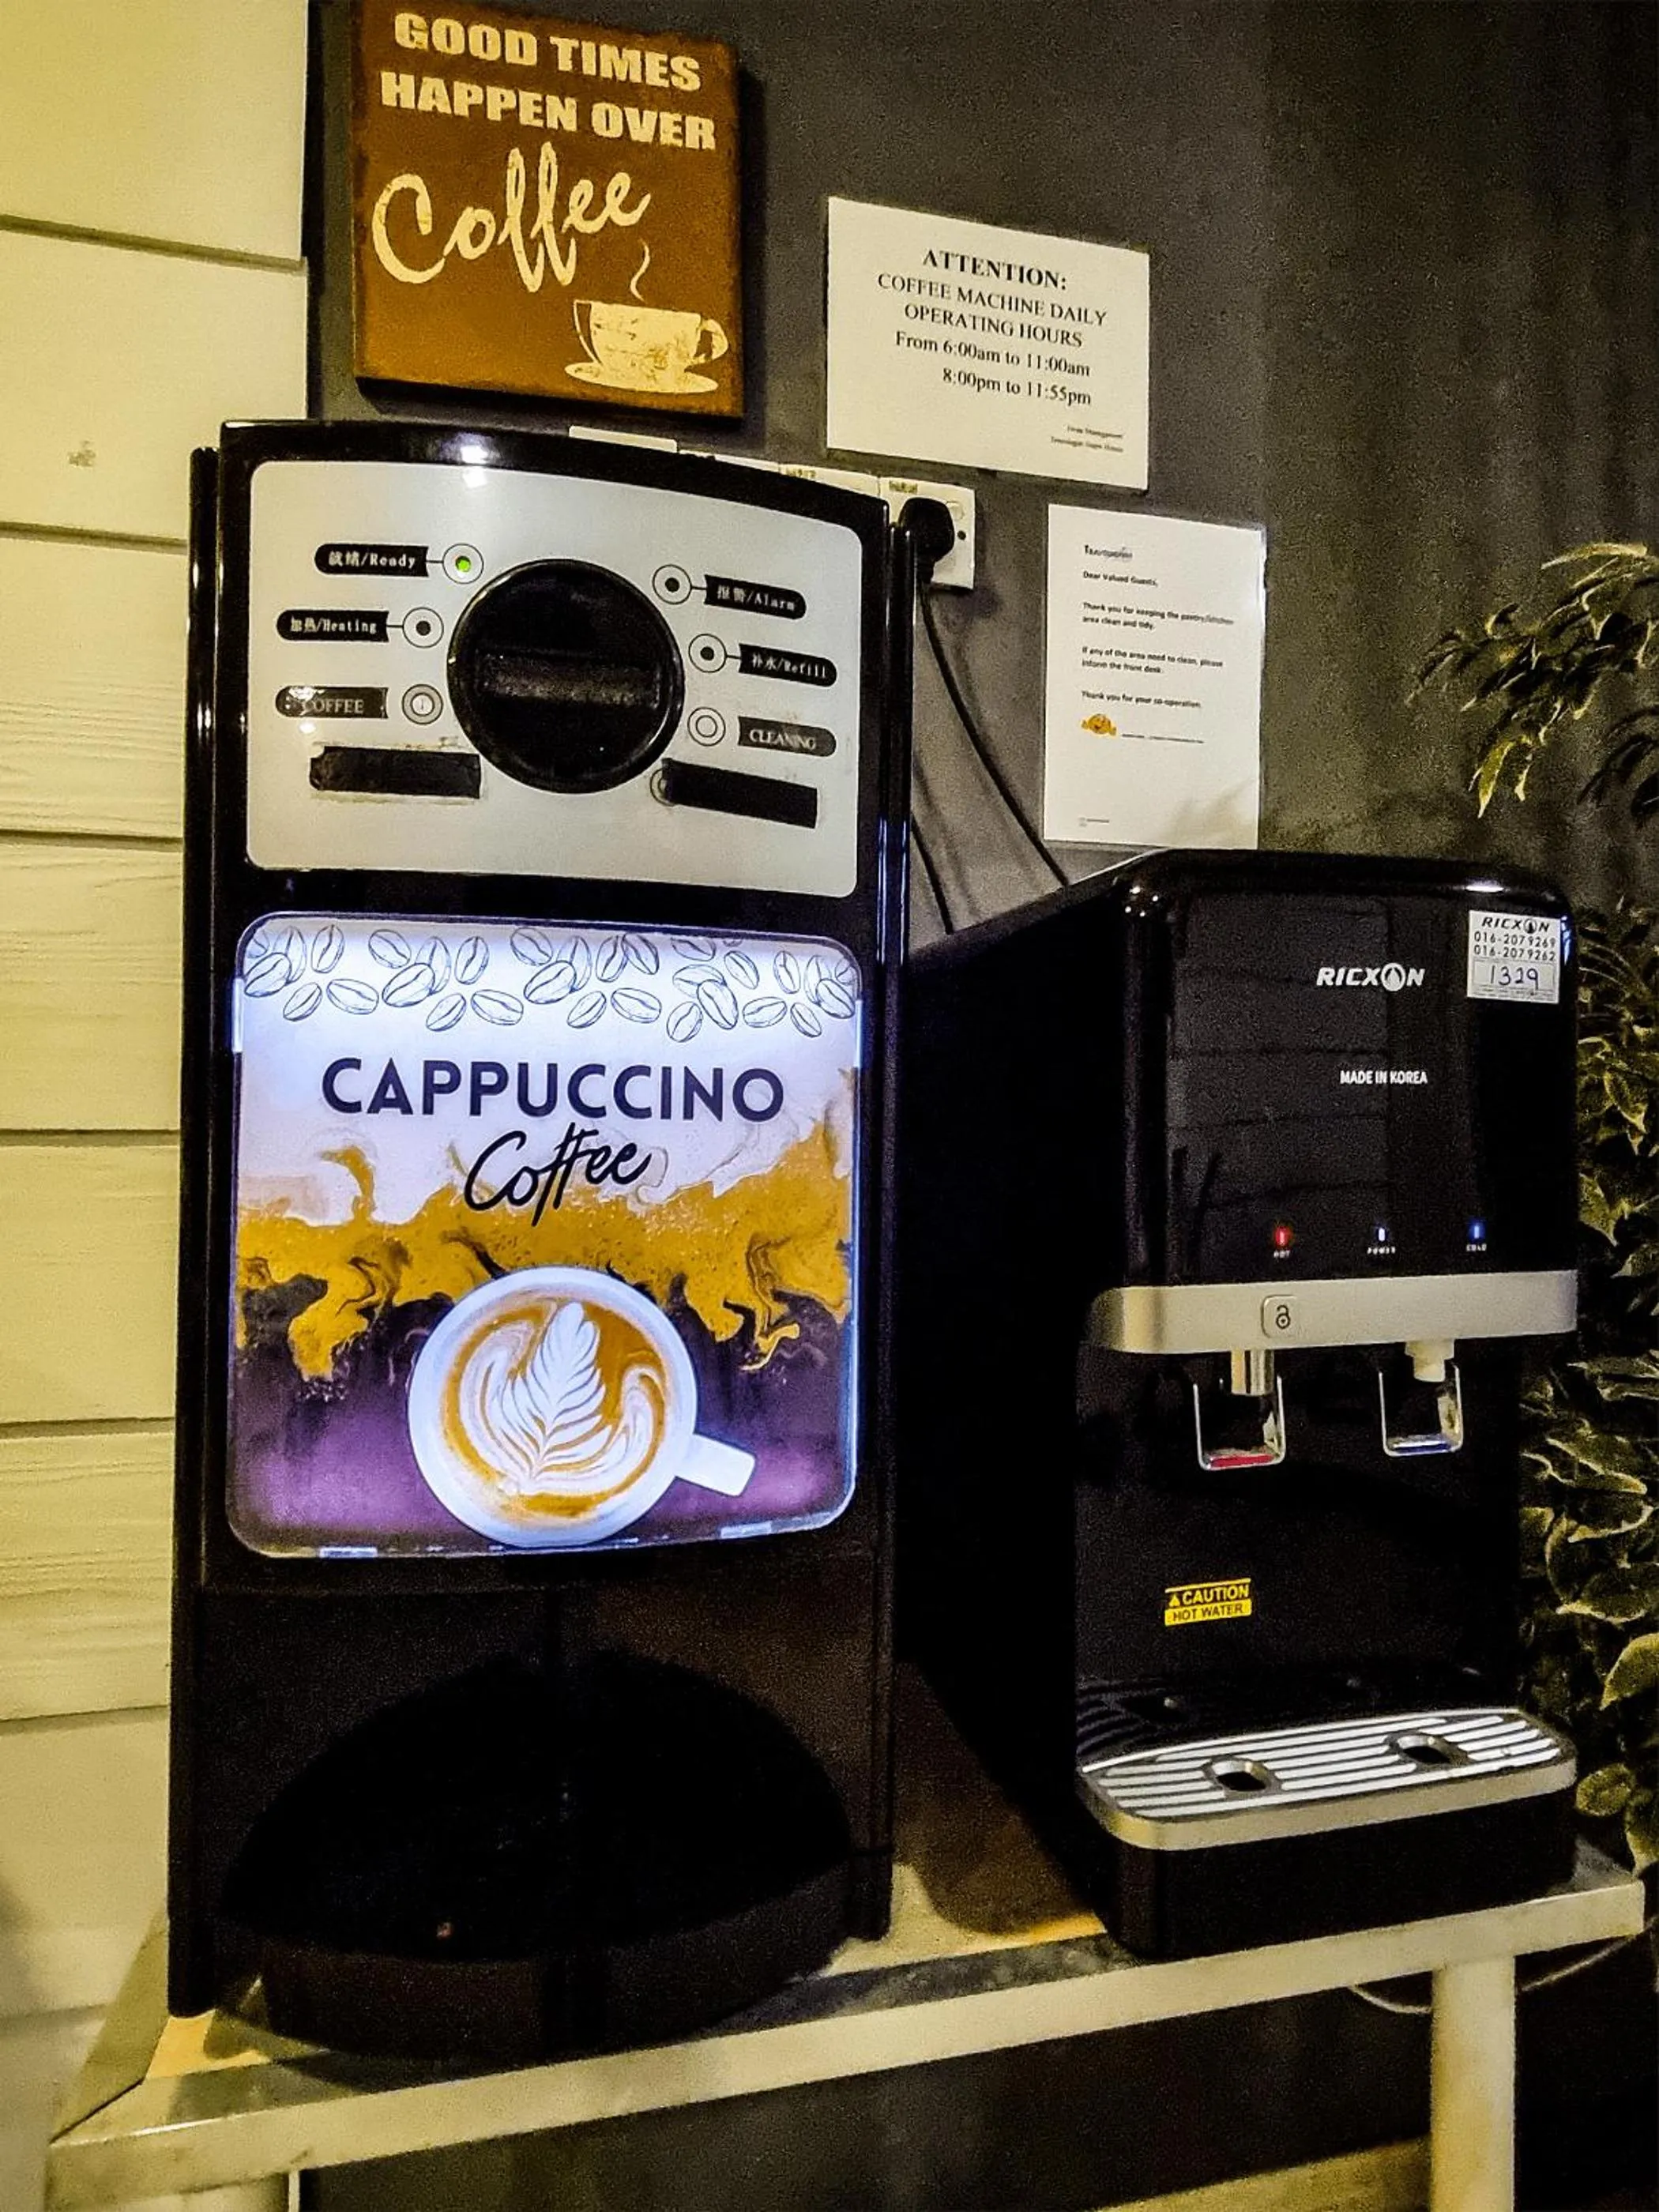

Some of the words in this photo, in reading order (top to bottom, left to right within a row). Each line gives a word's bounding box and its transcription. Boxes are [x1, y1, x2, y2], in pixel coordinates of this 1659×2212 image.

[394, 13, 538, 66] GOOD
[550, 36, 702, 92] TIMES
[380, 71, 578, 133] HAPPEN
[592, 103, 716, 150] OVER
[372, 141, 651, 292] Coffee
[923, 249, 1066, 291] ATTENTION:
[878, 273, 951, 299] COFFEE
[957, 286, 1044, 317] MACHINE
[1050, 303, 1107, 325] DAILY
[905, 303, 1014, 337] OPERATING
[1020, 323, 1082, 347] HOURS
[896, 330, 938, 352] From
[943, 340, 1000, 363] 6:00am
[1006, 352, 1020, 366] to
[1027, 353, 1090, 377] 11:00am
[942, 367, 1001, 392] 8:00pm
[1006, 381, 1021, 395] to
[1028, 381, 1091, 406] 11:55pm
[1083, 570, 1100, 580] Dear
[1103, 573, 1129, 583] Valued
[1083, 602, 1105, 611] Thank
[1167, 611, 1179, 619] the
[1109, 661, 1121, 670] the
[1115, 649, 1127, 658] the
[1082, 690, 1104, 700] Thank
[1106, 694, 1120, 702] you
[1122, 693, 1133, 702] for
[1135, 696, 1152, 705] your
[1482, 916, 1550, 934] RICXON
[1315, 962, 1425, 991] RICXON
[1490, 965, 1539, 991] 1329
[322, 1057, 784, 1123] CAPPUCCINO
[1340, 1070, 1373, 1085] MADE
[1375, 1070, 1387, 1085] IN
[1390, 1070, 1428, 1085] KOREA
[465, 1122, 653, 1227] Coffee
[1182, 1584, 1249, 1605] CAUTION
[1173, 1608, 1197, 1622] HOT
[1202, 1603, 1243, 1618] WATER
